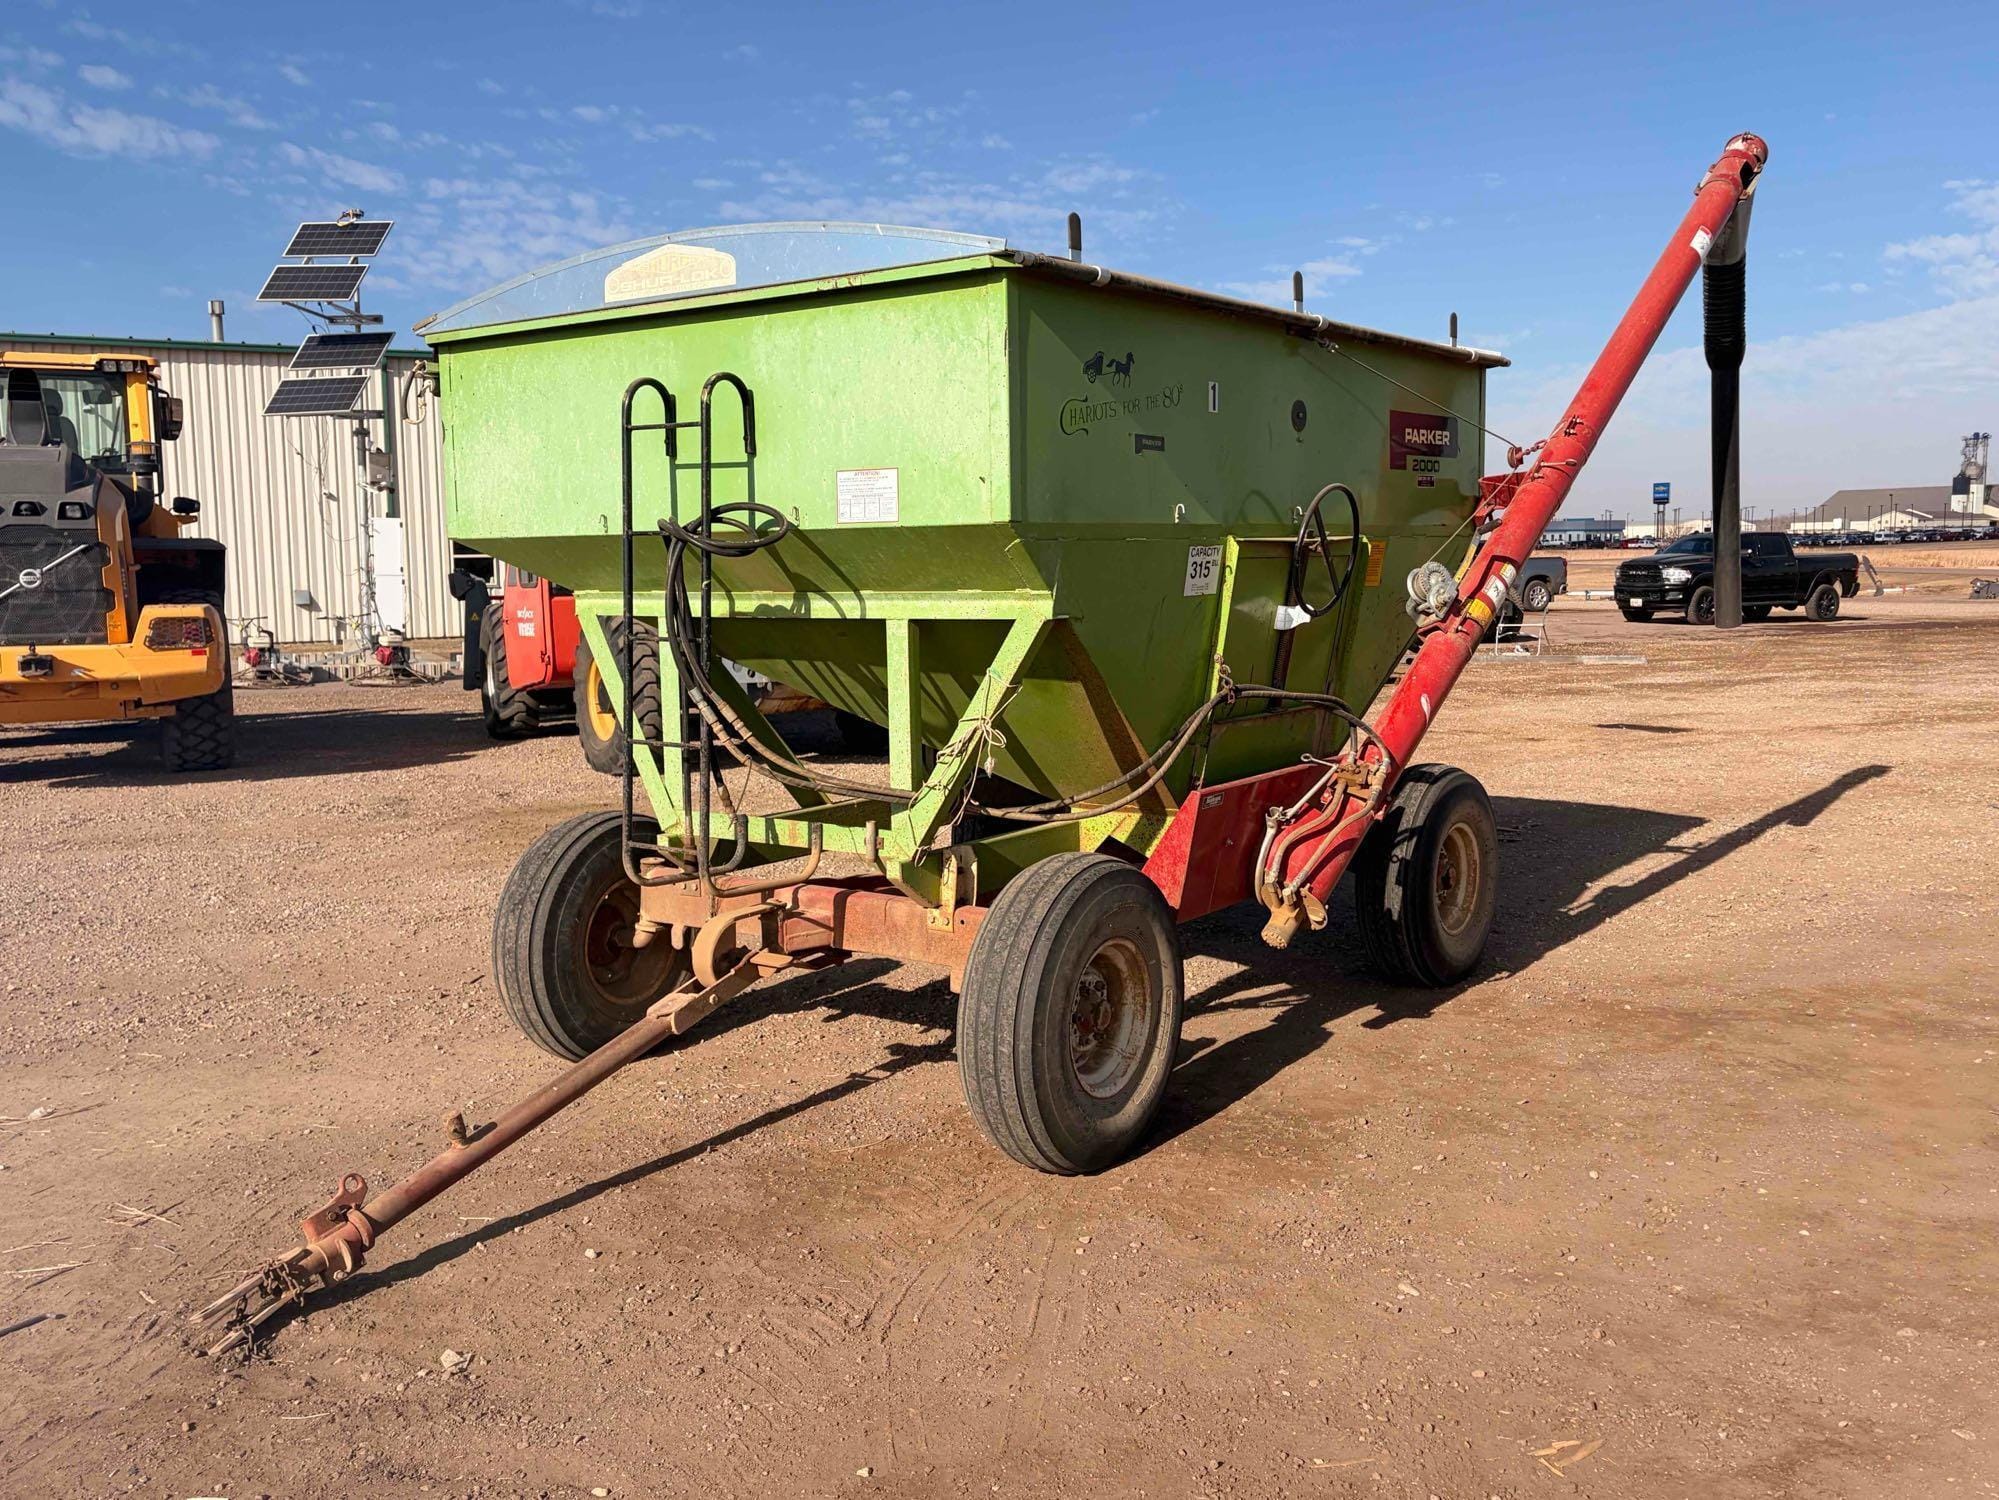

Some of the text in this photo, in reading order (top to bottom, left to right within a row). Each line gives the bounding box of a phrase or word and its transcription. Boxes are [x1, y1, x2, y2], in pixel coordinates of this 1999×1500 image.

[1060, 393, 1117, 436] CHARIOTS
[1123, 399, 1140, 416] FOR
[1146, 395, 1161, 409] THE
[1405, 427, 1450, 446] PARKER
[1412, 459, 1440, 473] 2000
[1190, 547, 1220, 557] CAPACITY
[1190, 561, 1211, 579] 315
